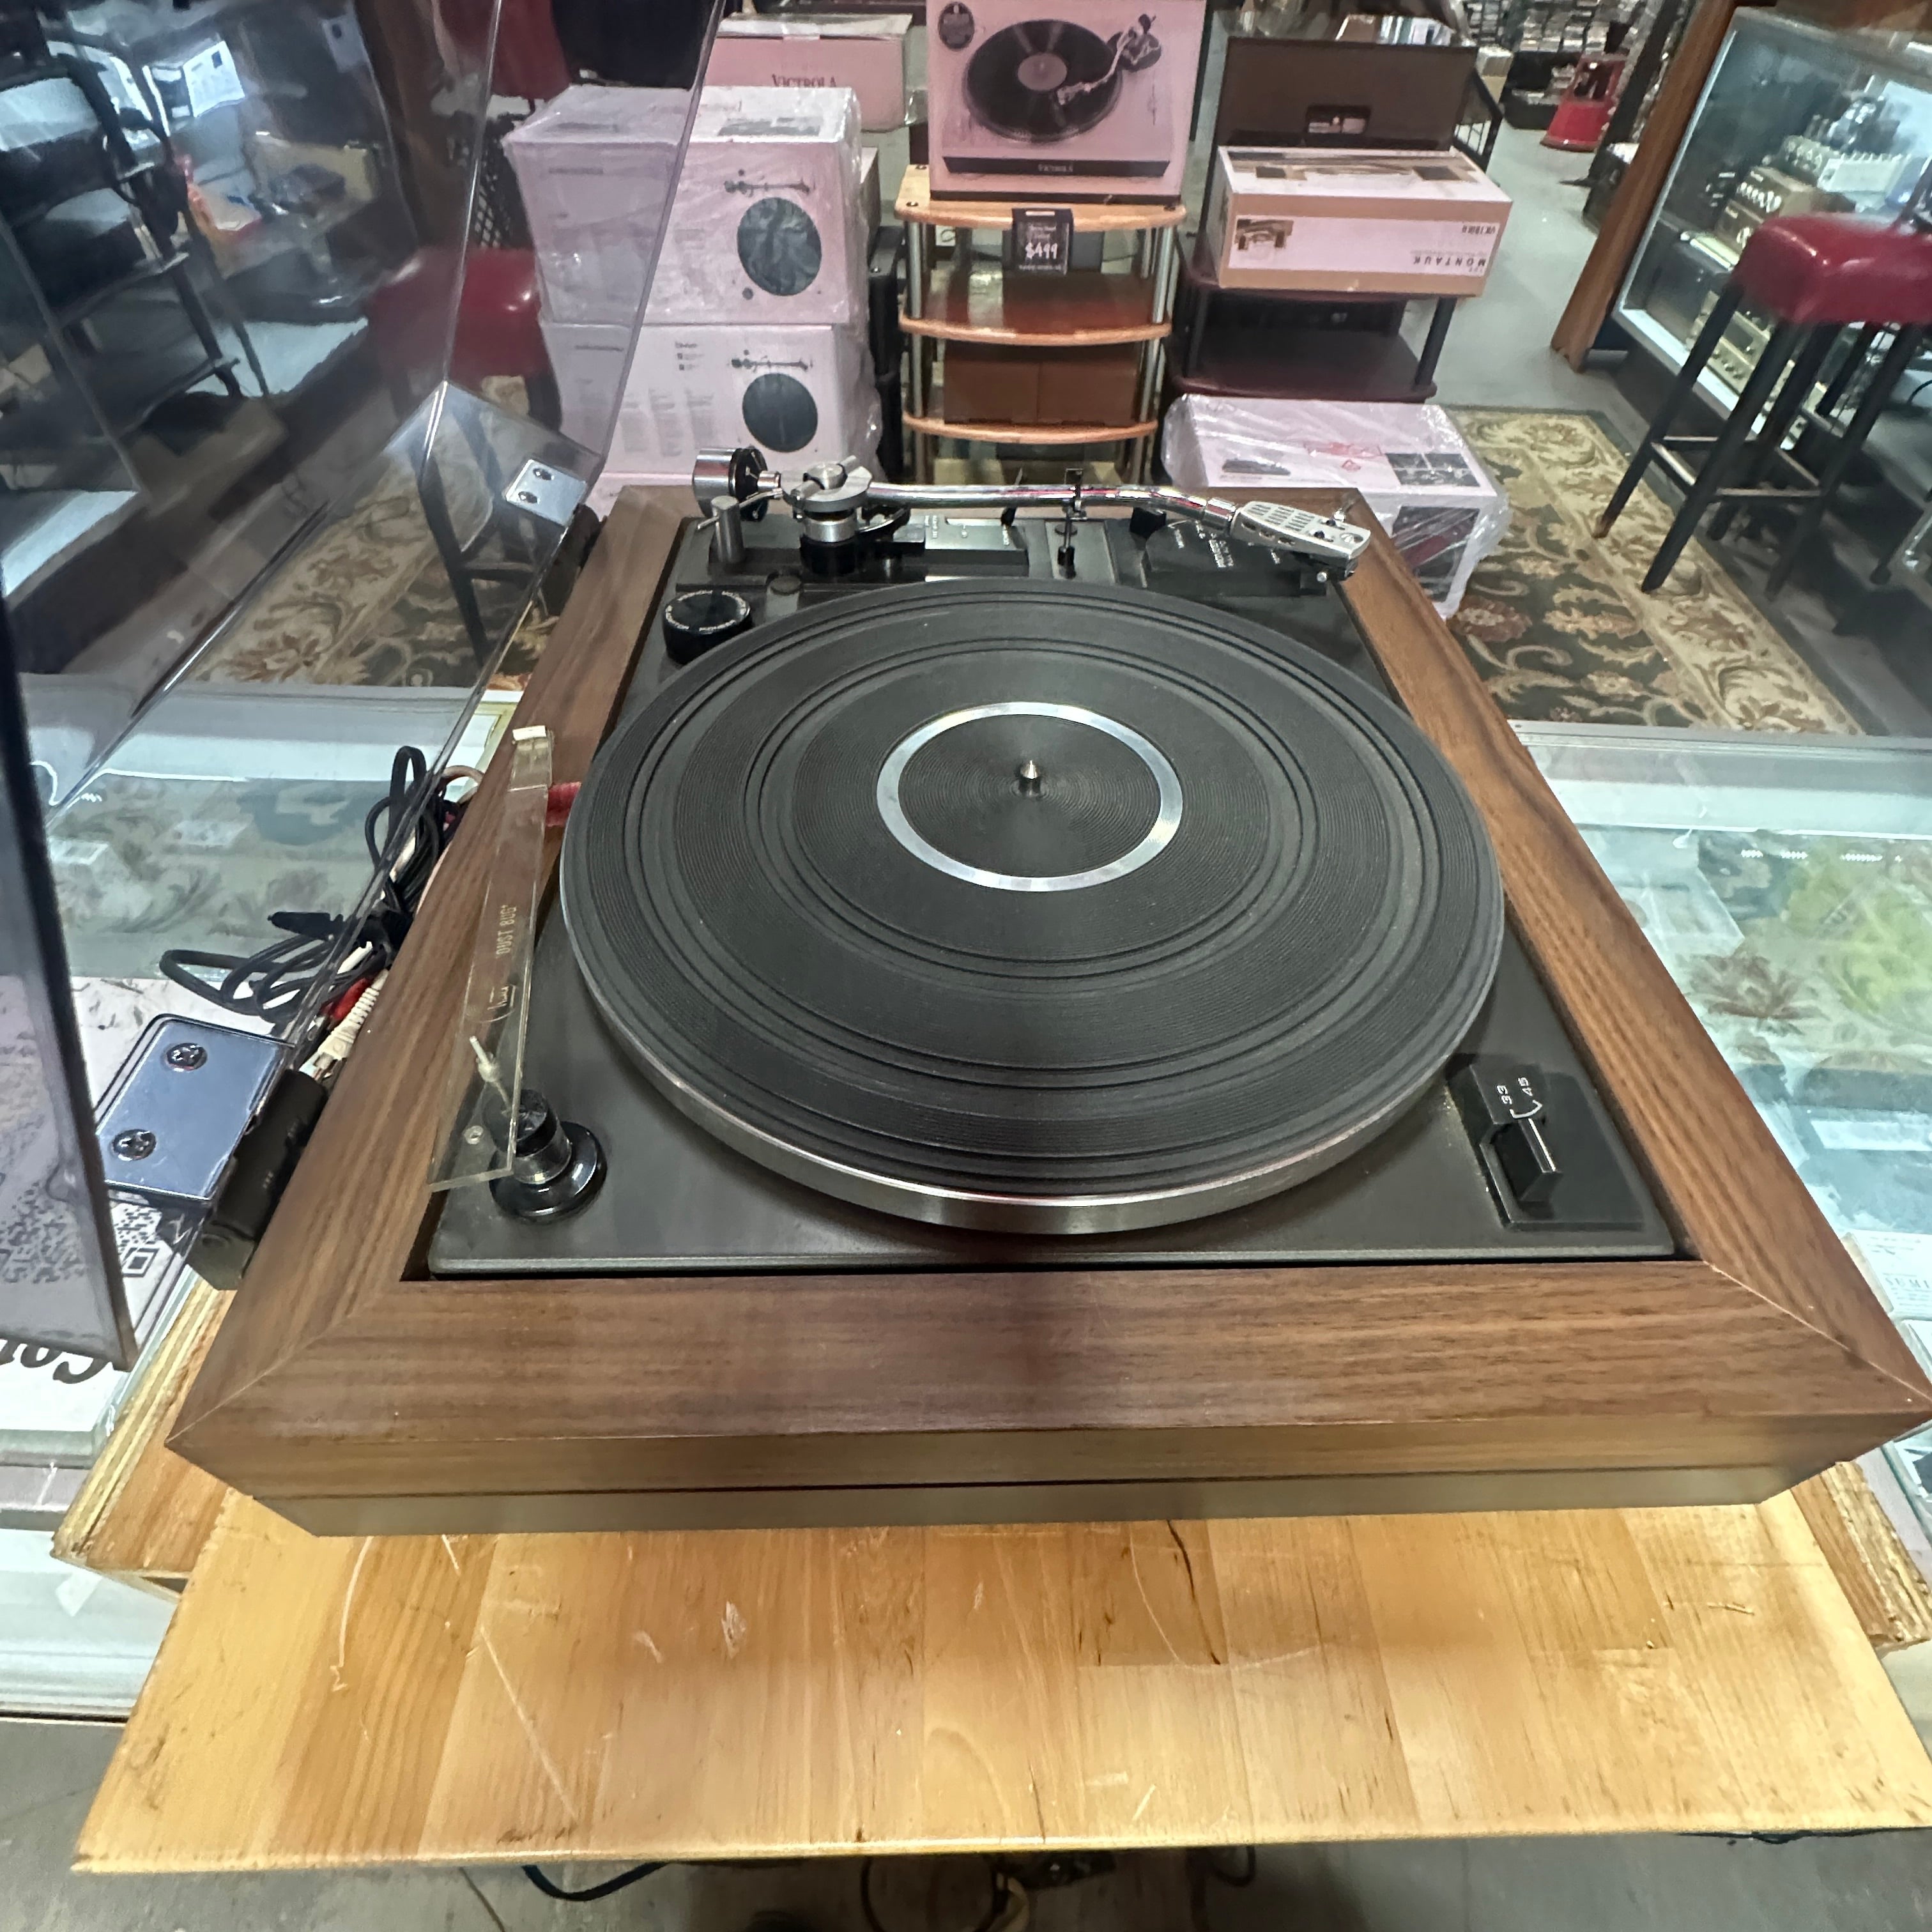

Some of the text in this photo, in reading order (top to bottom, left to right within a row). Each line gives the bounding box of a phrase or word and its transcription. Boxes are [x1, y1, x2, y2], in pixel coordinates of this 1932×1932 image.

[1025, 242, 1058, 259] $499
[1413, 256, 1486, 266] MONTAUK
[1496, 1085, 1512, 1105] 33
[1517, 1077, 1533, 1096] 45
